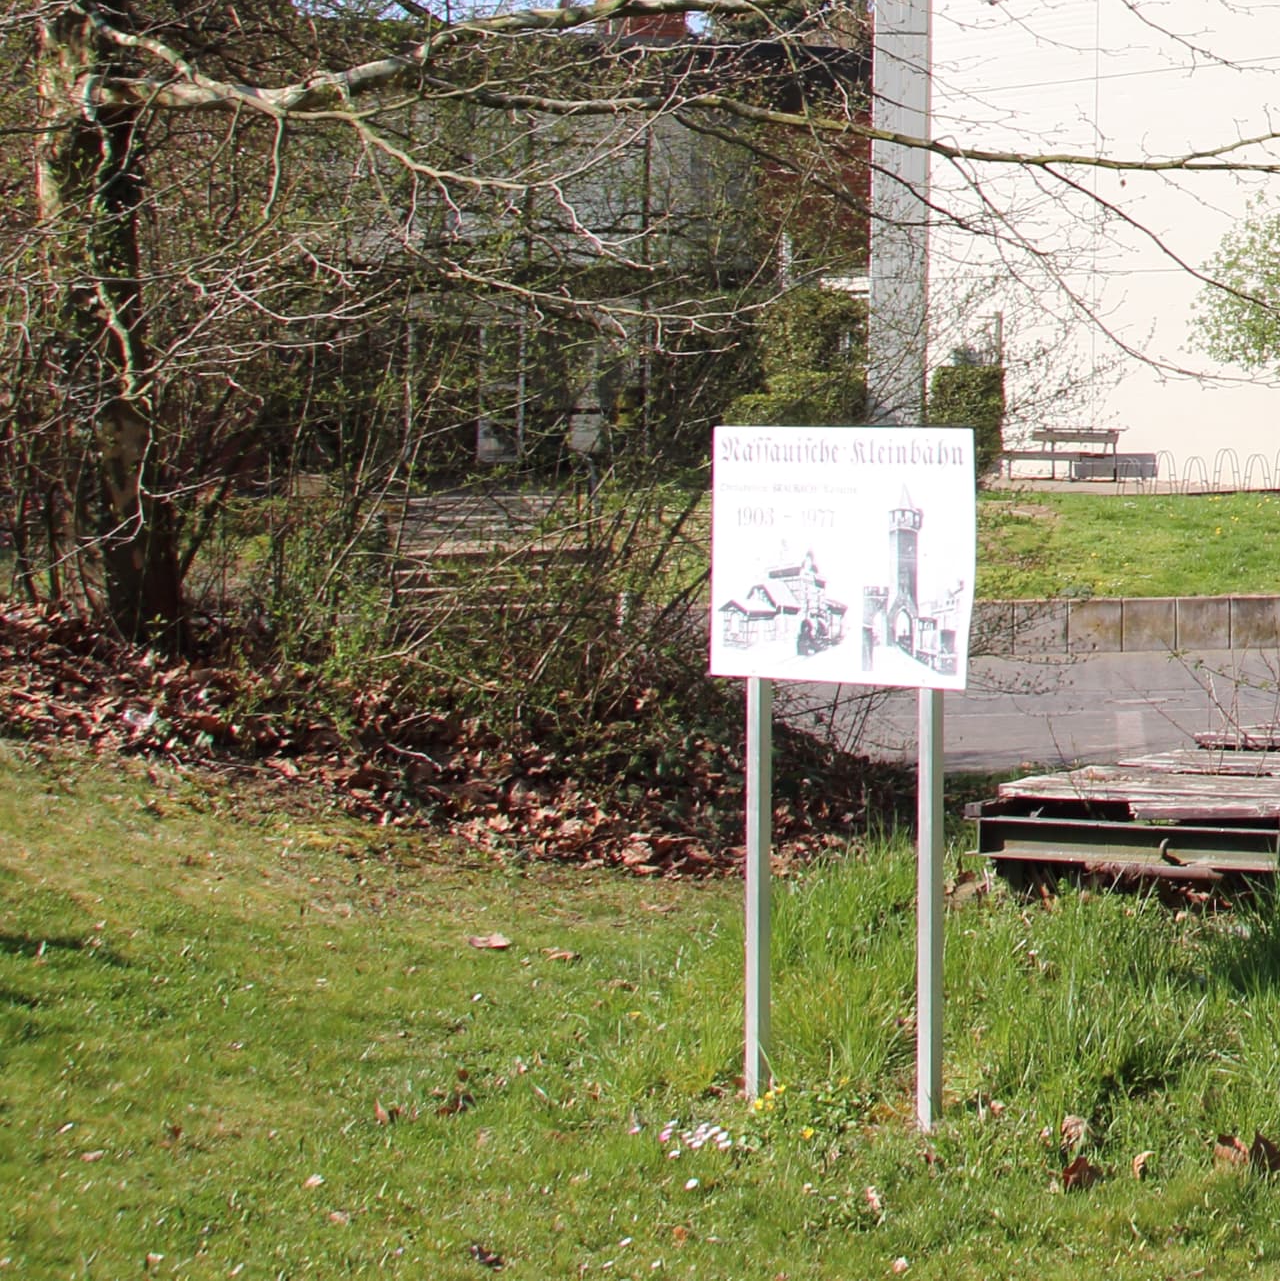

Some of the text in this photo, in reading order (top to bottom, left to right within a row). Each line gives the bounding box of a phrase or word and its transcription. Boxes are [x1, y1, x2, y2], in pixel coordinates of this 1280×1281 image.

[850, 437, 965, 469] Kleinbahn
[736, 506, 775, 528] 1903
[801, 507, 836, 528] 1977
